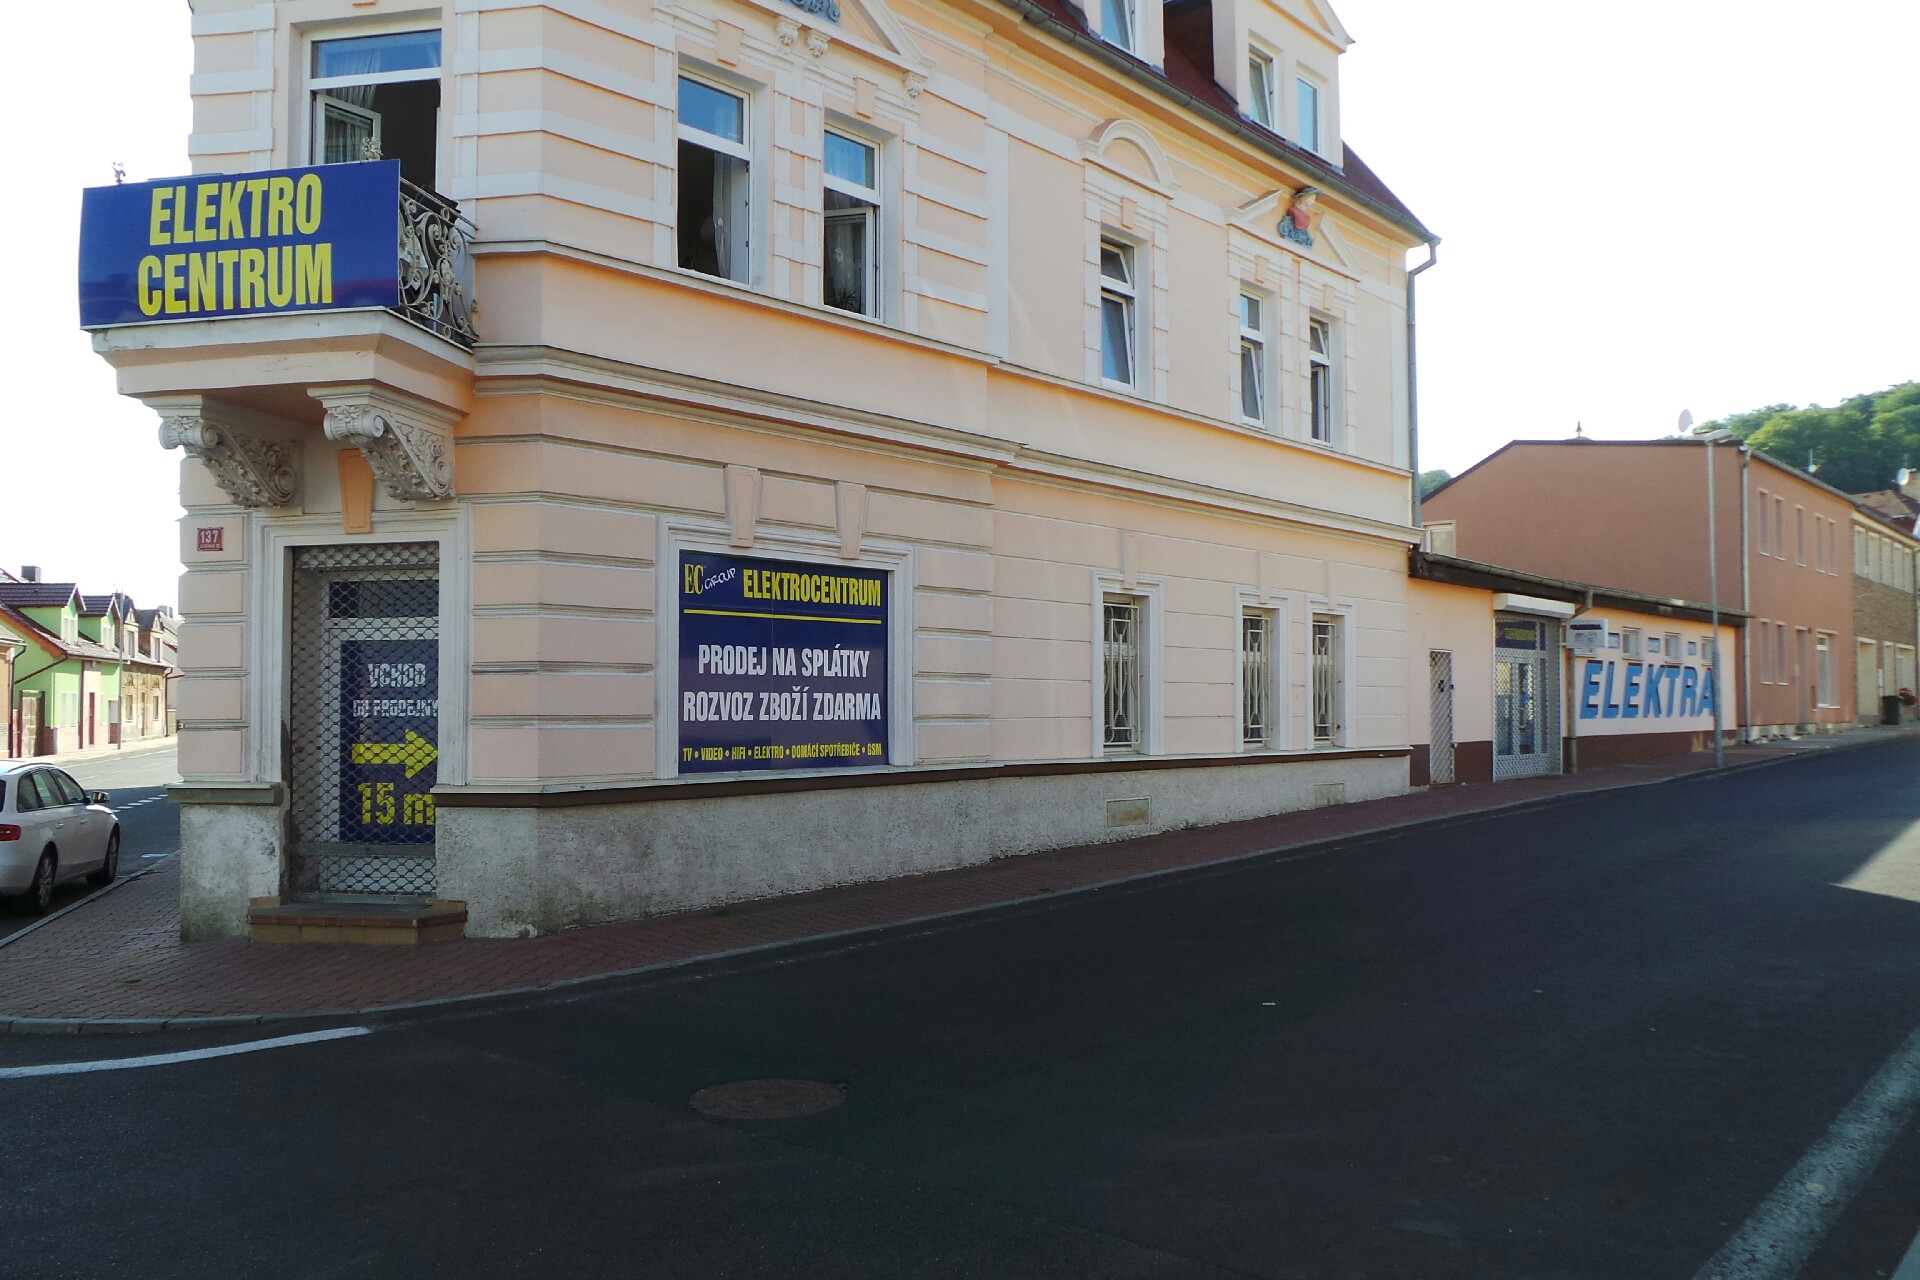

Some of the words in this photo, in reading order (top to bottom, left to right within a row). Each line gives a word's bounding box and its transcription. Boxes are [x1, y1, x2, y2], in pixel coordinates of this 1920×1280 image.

[149, 173, 323, 246] ELEKTRO
[137, 242, 333, 316] CENTRUM
[200, 530, 219, 544] 137
[684, 563, 704, 595] EC
[743, 568, 882, 607] ELEKTROCENTRUM
[368, 663, 426, 688] VCHOD
[698, 644, 767, 676] PRODEJ
[772, 647, 797, 676] NA
[801, 643, 870, 678] SPLÁTKY
[683, 691, 754, 722] ROZVOZ
[759, 685, 810, 722] ZBOŽÍ
[812, 692, 882, 721] ZDARMA
[1580, 659, 1713, 719] ELEKTRA
[683, 747, 693, 762] TV
[701, 746, 724, 761] VIDEO
[731, 746, 746, 760] HIFI
[753, 745, 784, 759] ELEKTRO
[791, 742, 819, 759] DOMÁCÍ
[820, 742, 860, 758] SPOTŘEBIČE
[867, 742, 882, 756] GSM
[357, 782, 396, 825] 15
[403, 793, 435, 826] m
